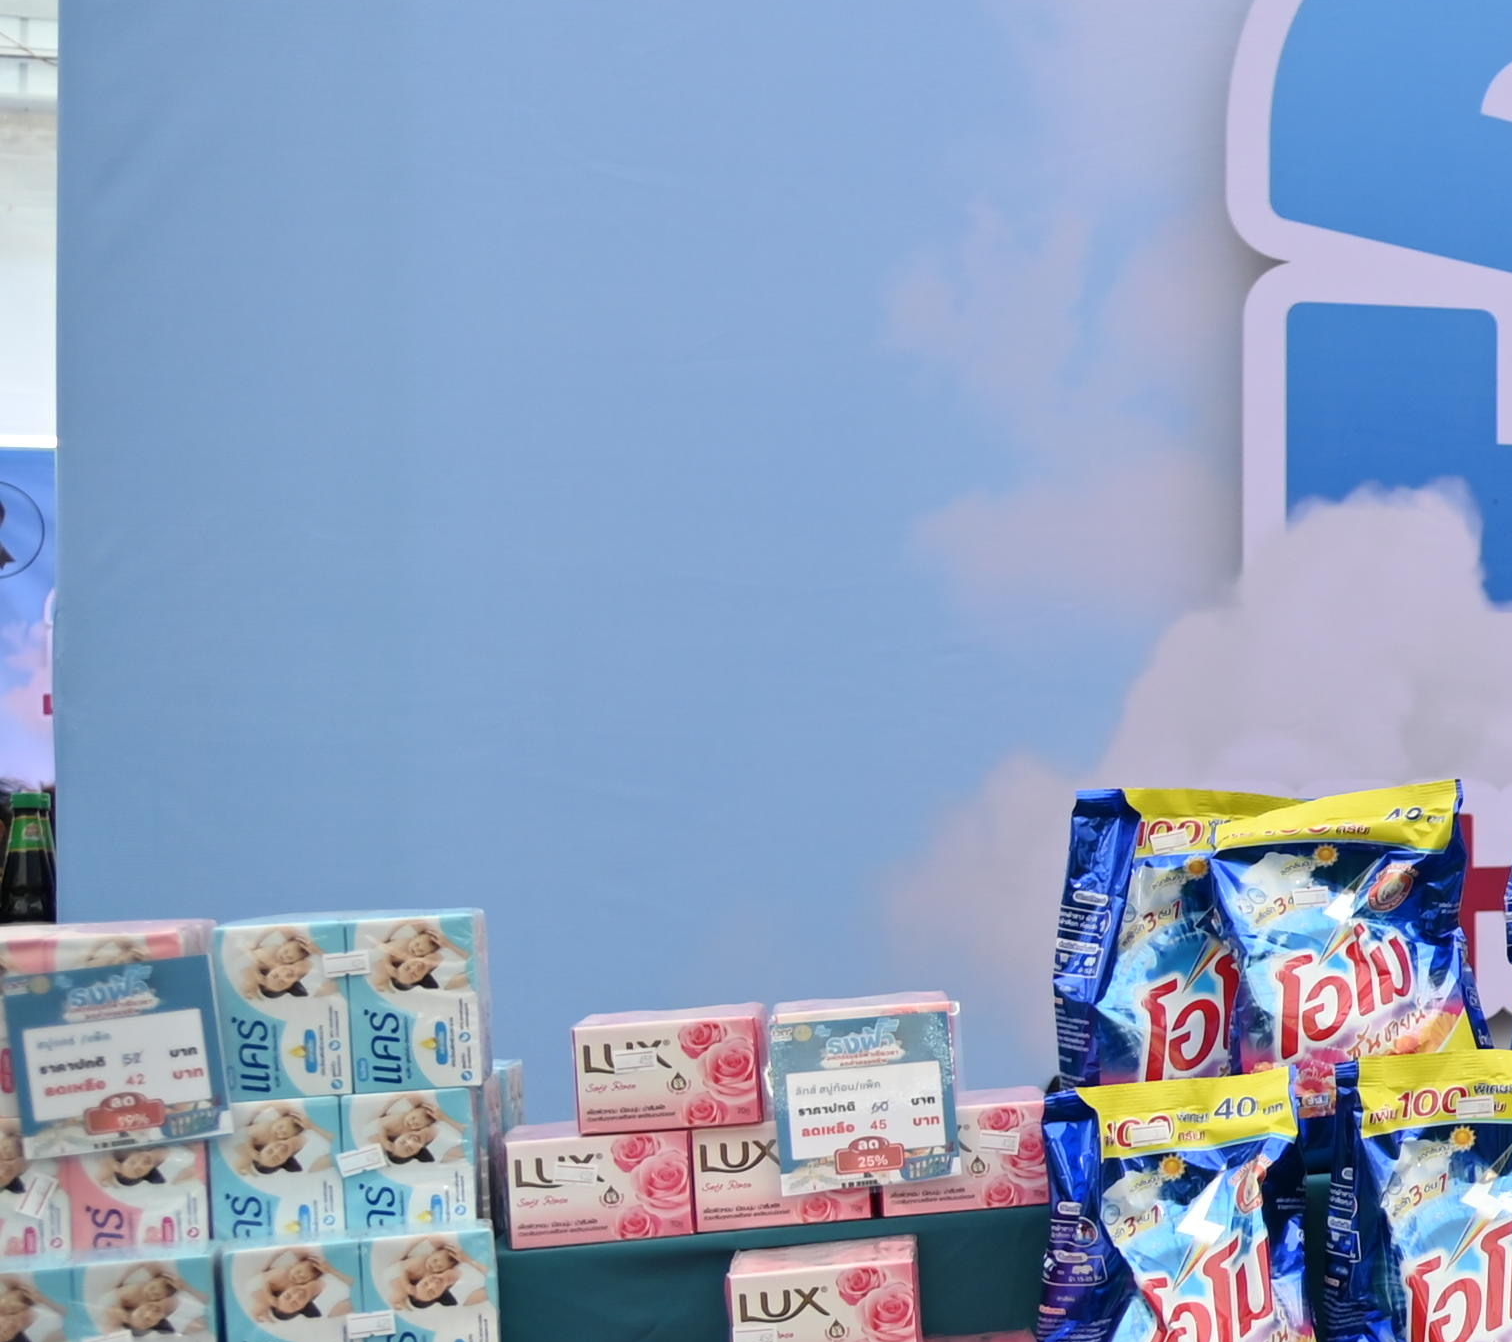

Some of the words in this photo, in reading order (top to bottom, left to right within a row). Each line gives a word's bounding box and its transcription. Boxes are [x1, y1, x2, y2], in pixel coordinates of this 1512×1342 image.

[1276, 923, 1414, 1059] โอโม
[826, 1018, 899, 1055] ธงฟ้า
[39, 1056, 107, 1075] ราคาปกติ
[169, 1046, 199, 1058] บาท
[44, 1077, 107, 1096] ลดเหลือ
[125, 1073, 146, 1086] 42
[172, 1067, 204, 1080] บาท
[798, 1101, 856, 1117] ราคาปกติ
[910, 1095, 936, 1106] บาท
[801, 1121, 856, 1138] ลดเหลือ
[869, 1119, 888, 1131] 45
[912, 1115, 941, 1127] บาท
[857, 1140, 880, 1151] ลด
[857, 1155, 889, 1168] 25%
[738, 1285, 829, 1324] LUX
